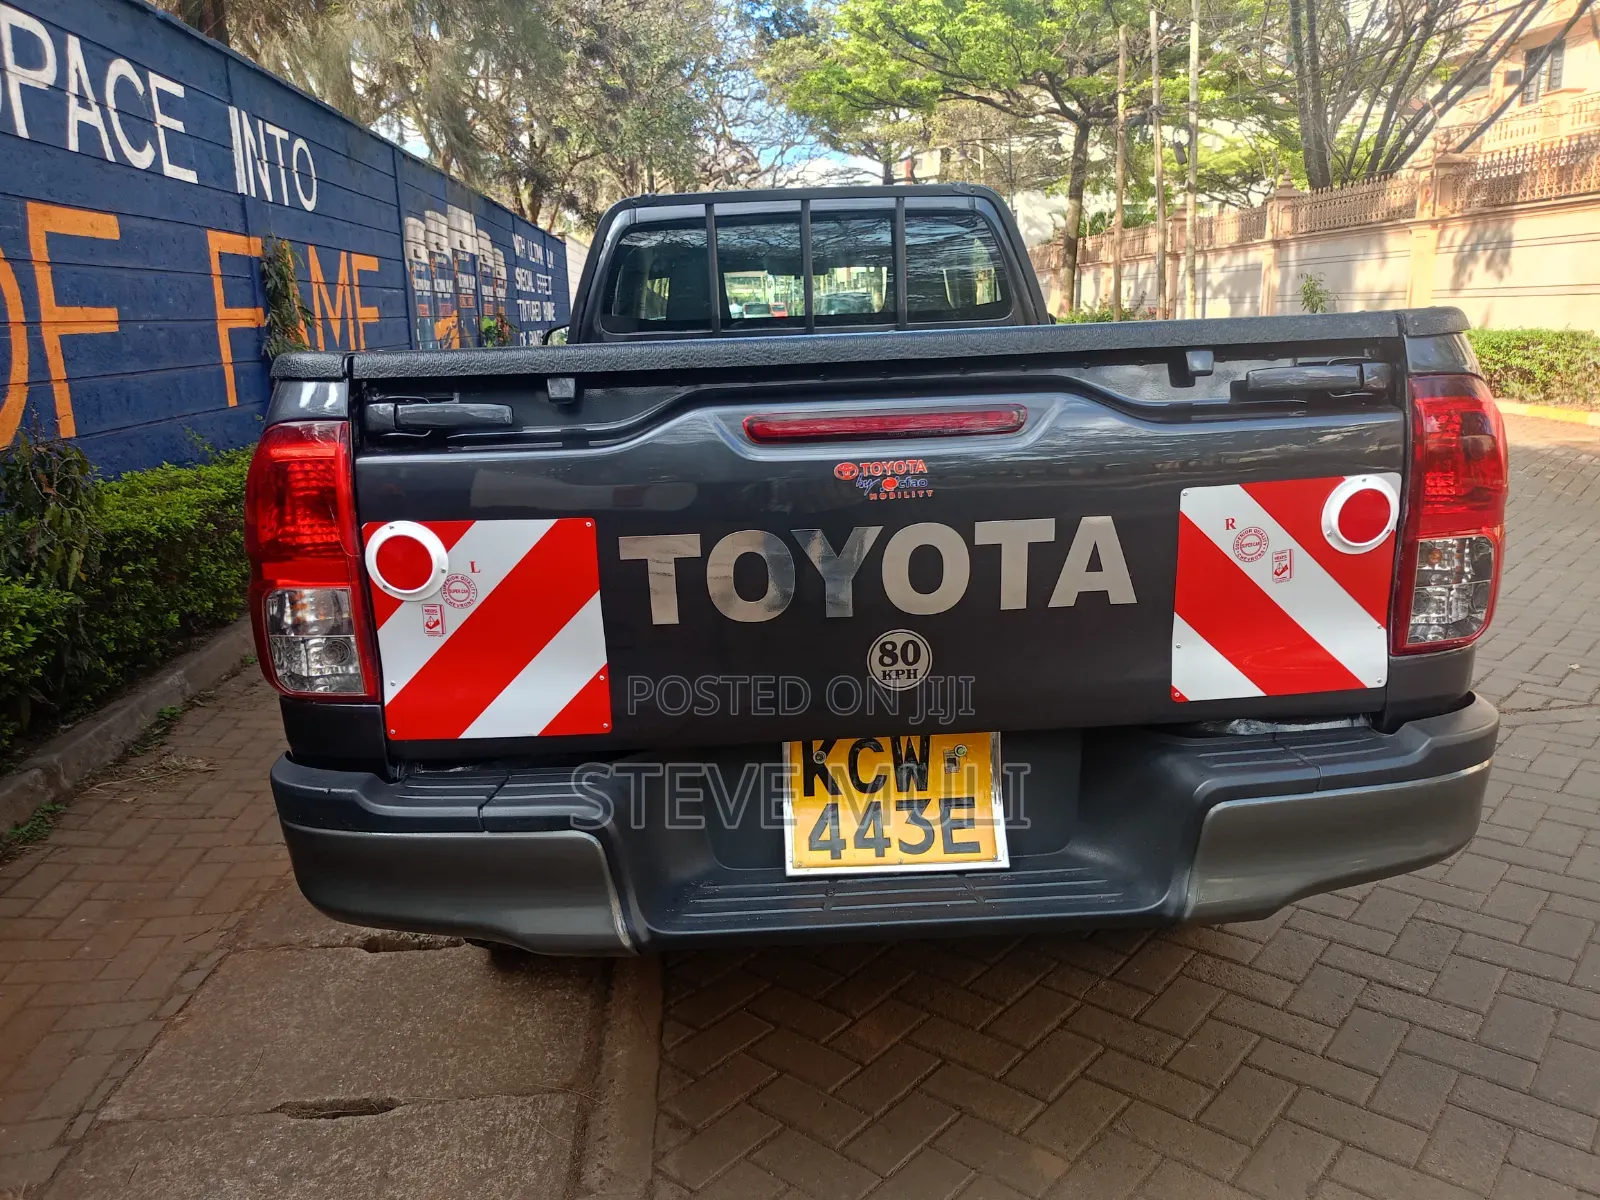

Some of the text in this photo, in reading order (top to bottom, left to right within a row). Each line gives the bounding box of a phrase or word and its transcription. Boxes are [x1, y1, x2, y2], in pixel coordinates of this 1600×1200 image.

[0, 3, 318, 212] PACE INTO
[860, 459, 927, 476] TOYOTA
[856, 473, 928, 496] by cfao
[868, 490, 934, 501] MOBILITY
[1225, 517, 1237, 531] R
[1234, 528, 1253, 551] SUPERIOR
[469, 561, 481, 574] L
[617, 515, 1138, 626] TOYOTA
[878, 639, 922, 667] 80
[881, 667, 919, 681] KPH
[803, 735, 931, 797] KCW
[808, 796, 982, 861] 443E
